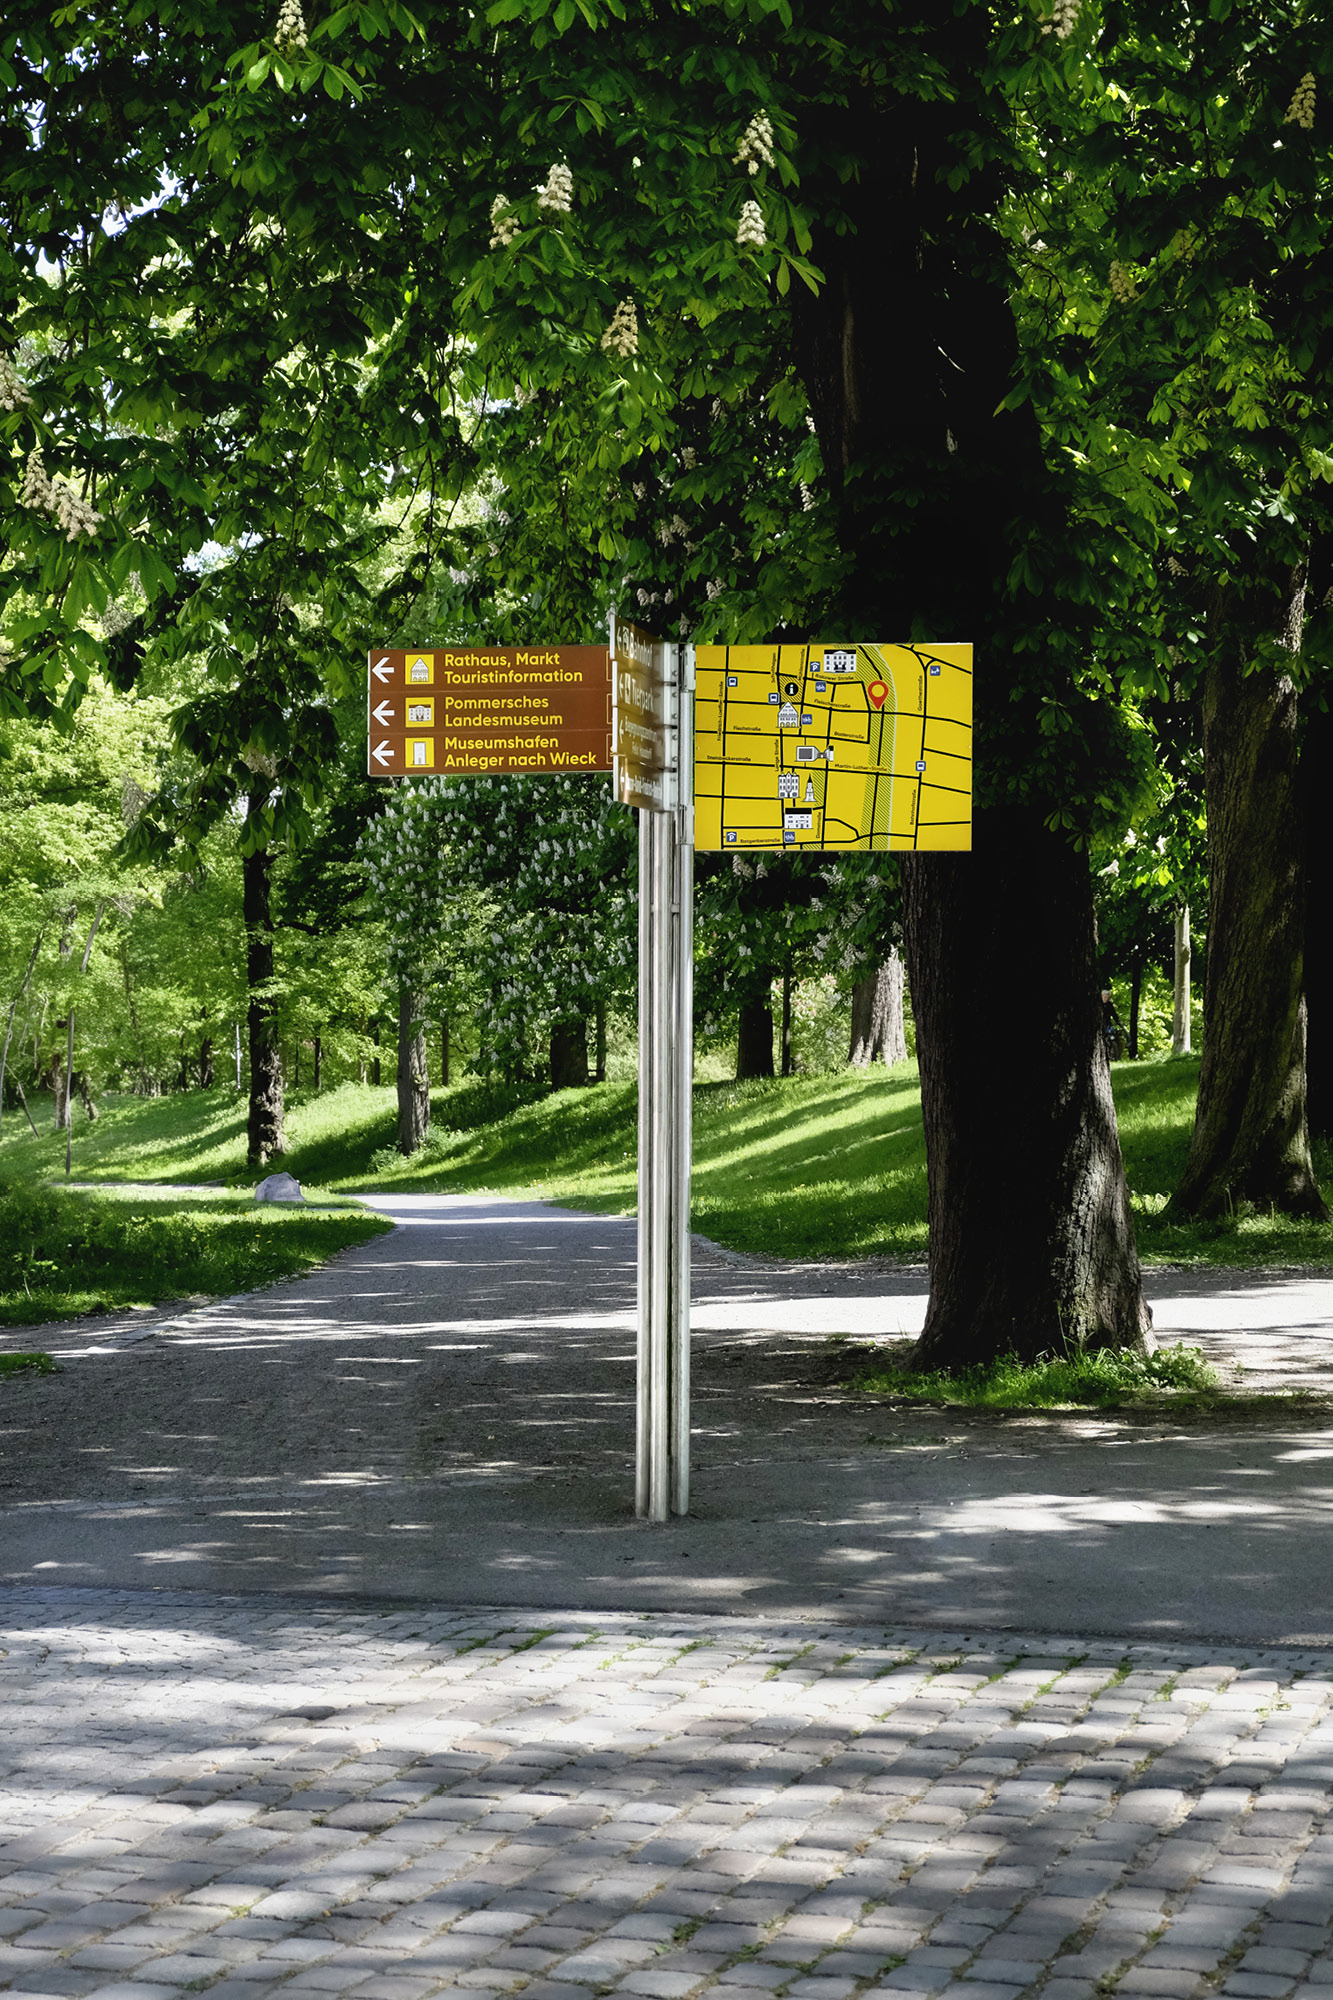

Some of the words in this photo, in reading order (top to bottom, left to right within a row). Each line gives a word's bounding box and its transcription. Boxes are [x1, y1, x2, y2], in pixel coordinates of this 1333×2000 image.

[444, 653, 511, 668] Rathaus,
[516, 652, 560, 665] Markt
[444, 670, 583, 684] Touristinformation
[445, 695, 549, 709] Pommersches
[631, 678, 655, 716] Tierpark
[445, 713, 563, 727] Landesmuseum
[445, 735, 558, 749] Museumshafen
[444, 754, 505, 769] Anleger
[509, 753, 546, 766] nach
[550, 752, 597, 765] Wieck
